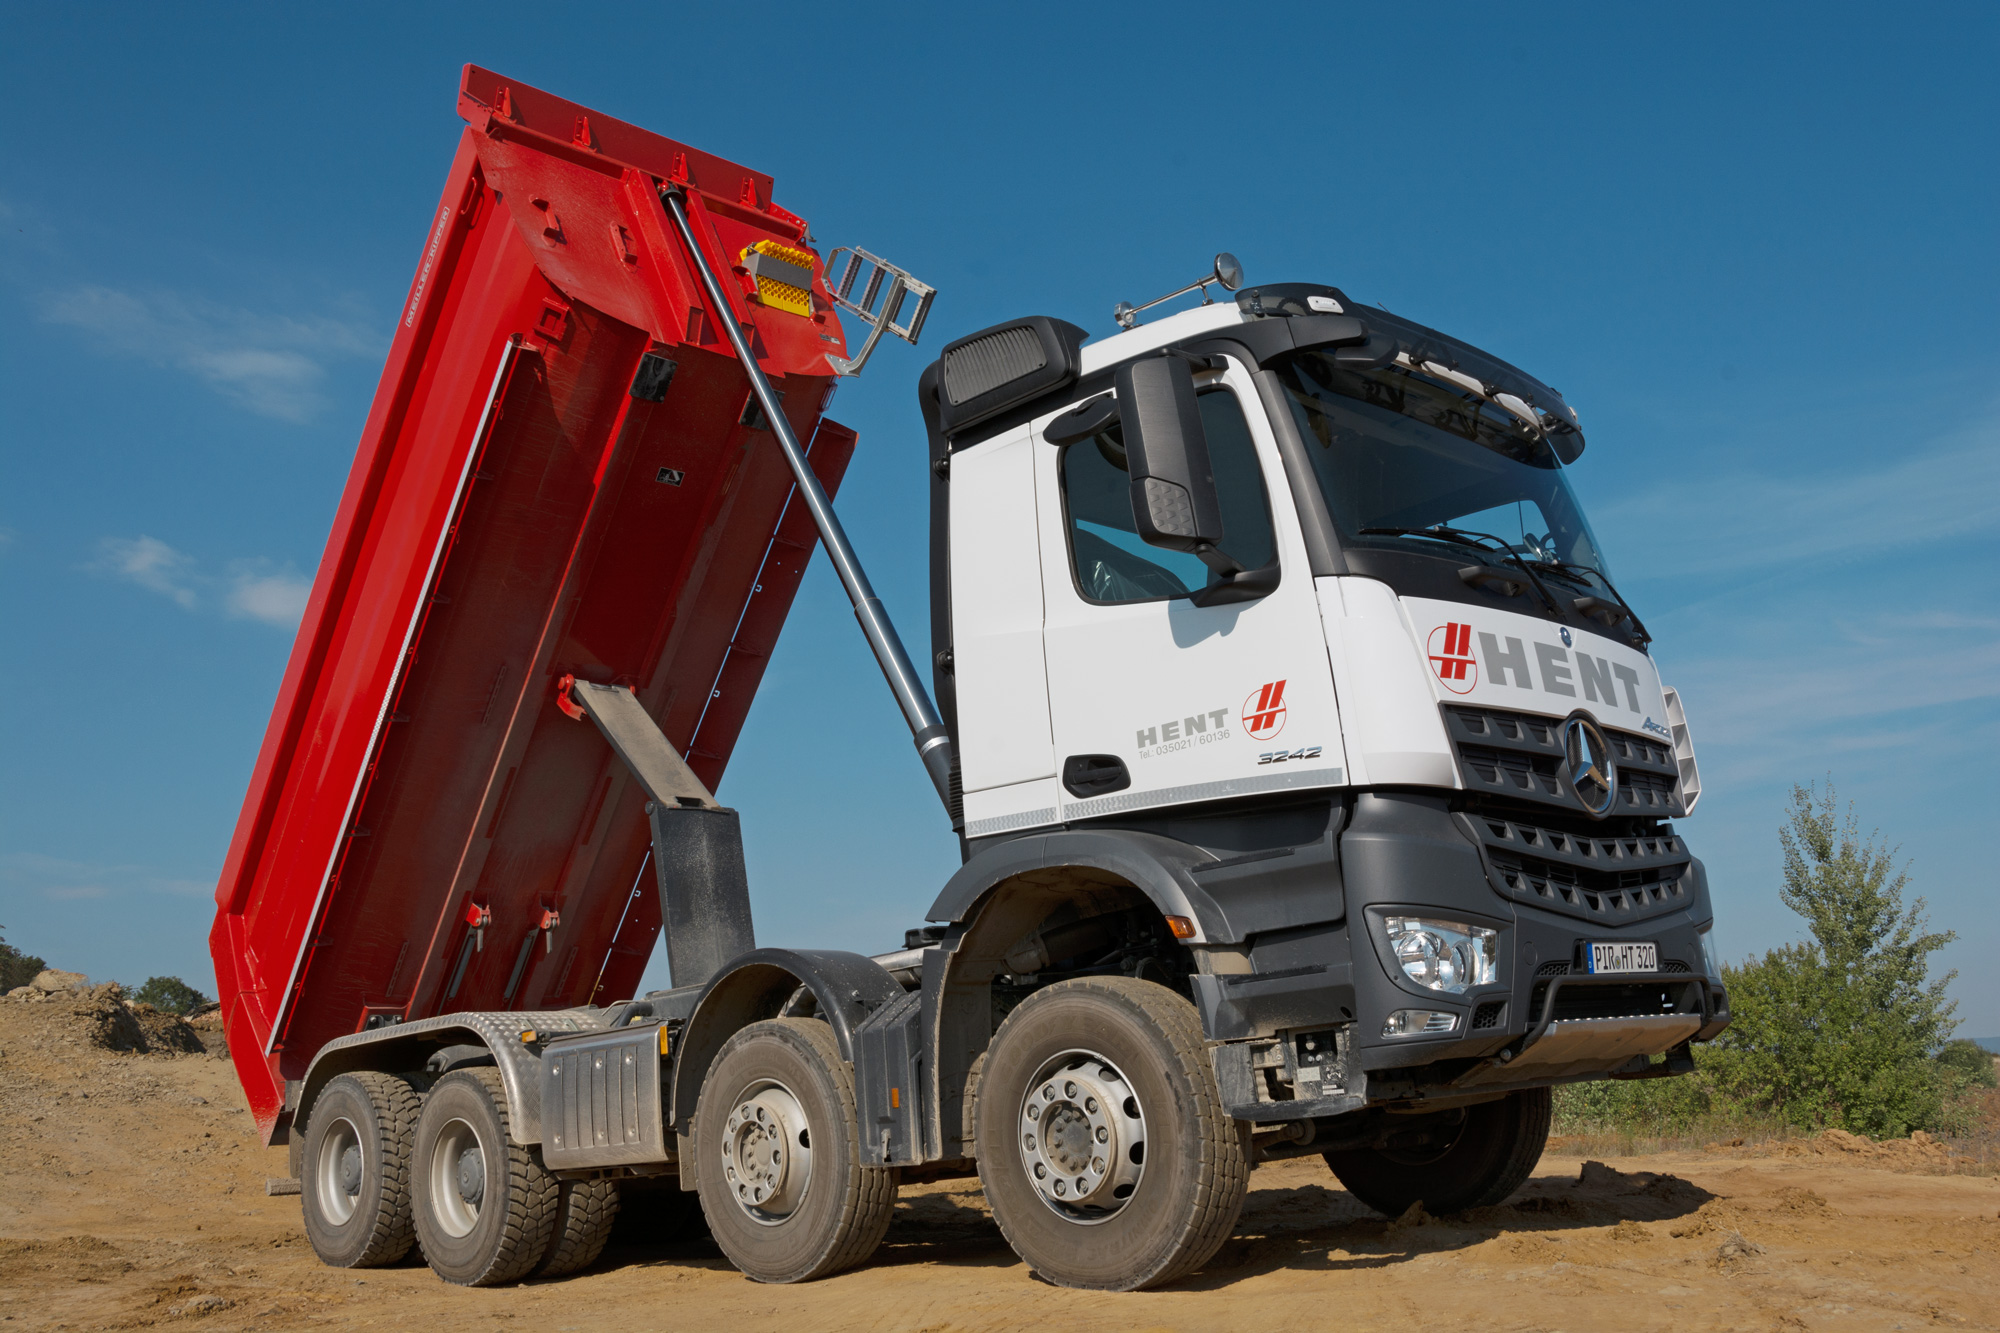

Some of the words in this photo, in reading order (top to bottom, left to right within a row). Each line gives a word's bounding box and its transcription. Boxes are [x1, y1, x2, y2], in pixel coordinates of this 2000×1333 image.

[1477, 631, 1641, 714] HENT
[1136, 707, 1229, 749] HENT
[1156, 738, 1191, 756] 035021
[1199, 728, 1231, 745] 60136
[1257, 745, 1323, 765] 3242
[1594, 945, 1616, 970] PIR
[1620, 945, 1634, 970] HT
[1636, 945, 1655, 969] 320
